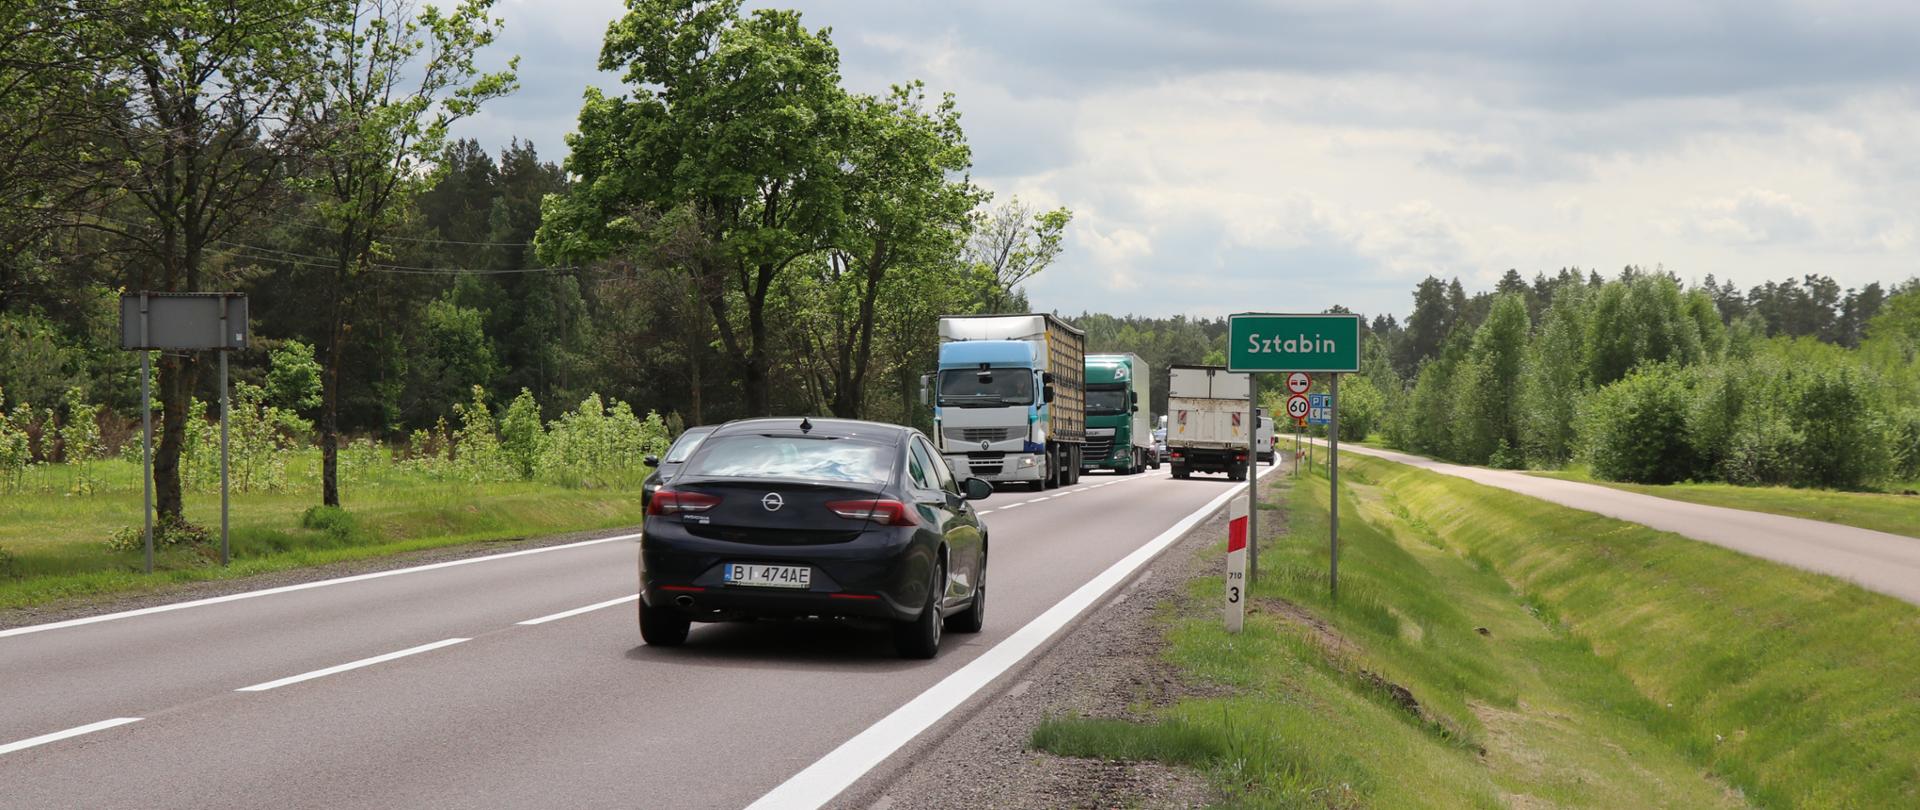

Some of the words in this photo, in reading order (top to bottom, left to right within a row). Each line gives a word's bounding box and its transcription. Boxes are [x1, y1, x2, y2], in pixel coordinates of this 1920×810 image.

[1247, 333, 1336, 353] Sztabin
[1290, 401, 1306, 412] 60
[734, 566, 752, 580] BI
[761, 567, 808, 583] 474AE
[1229, 587, 1239, 603] 3
